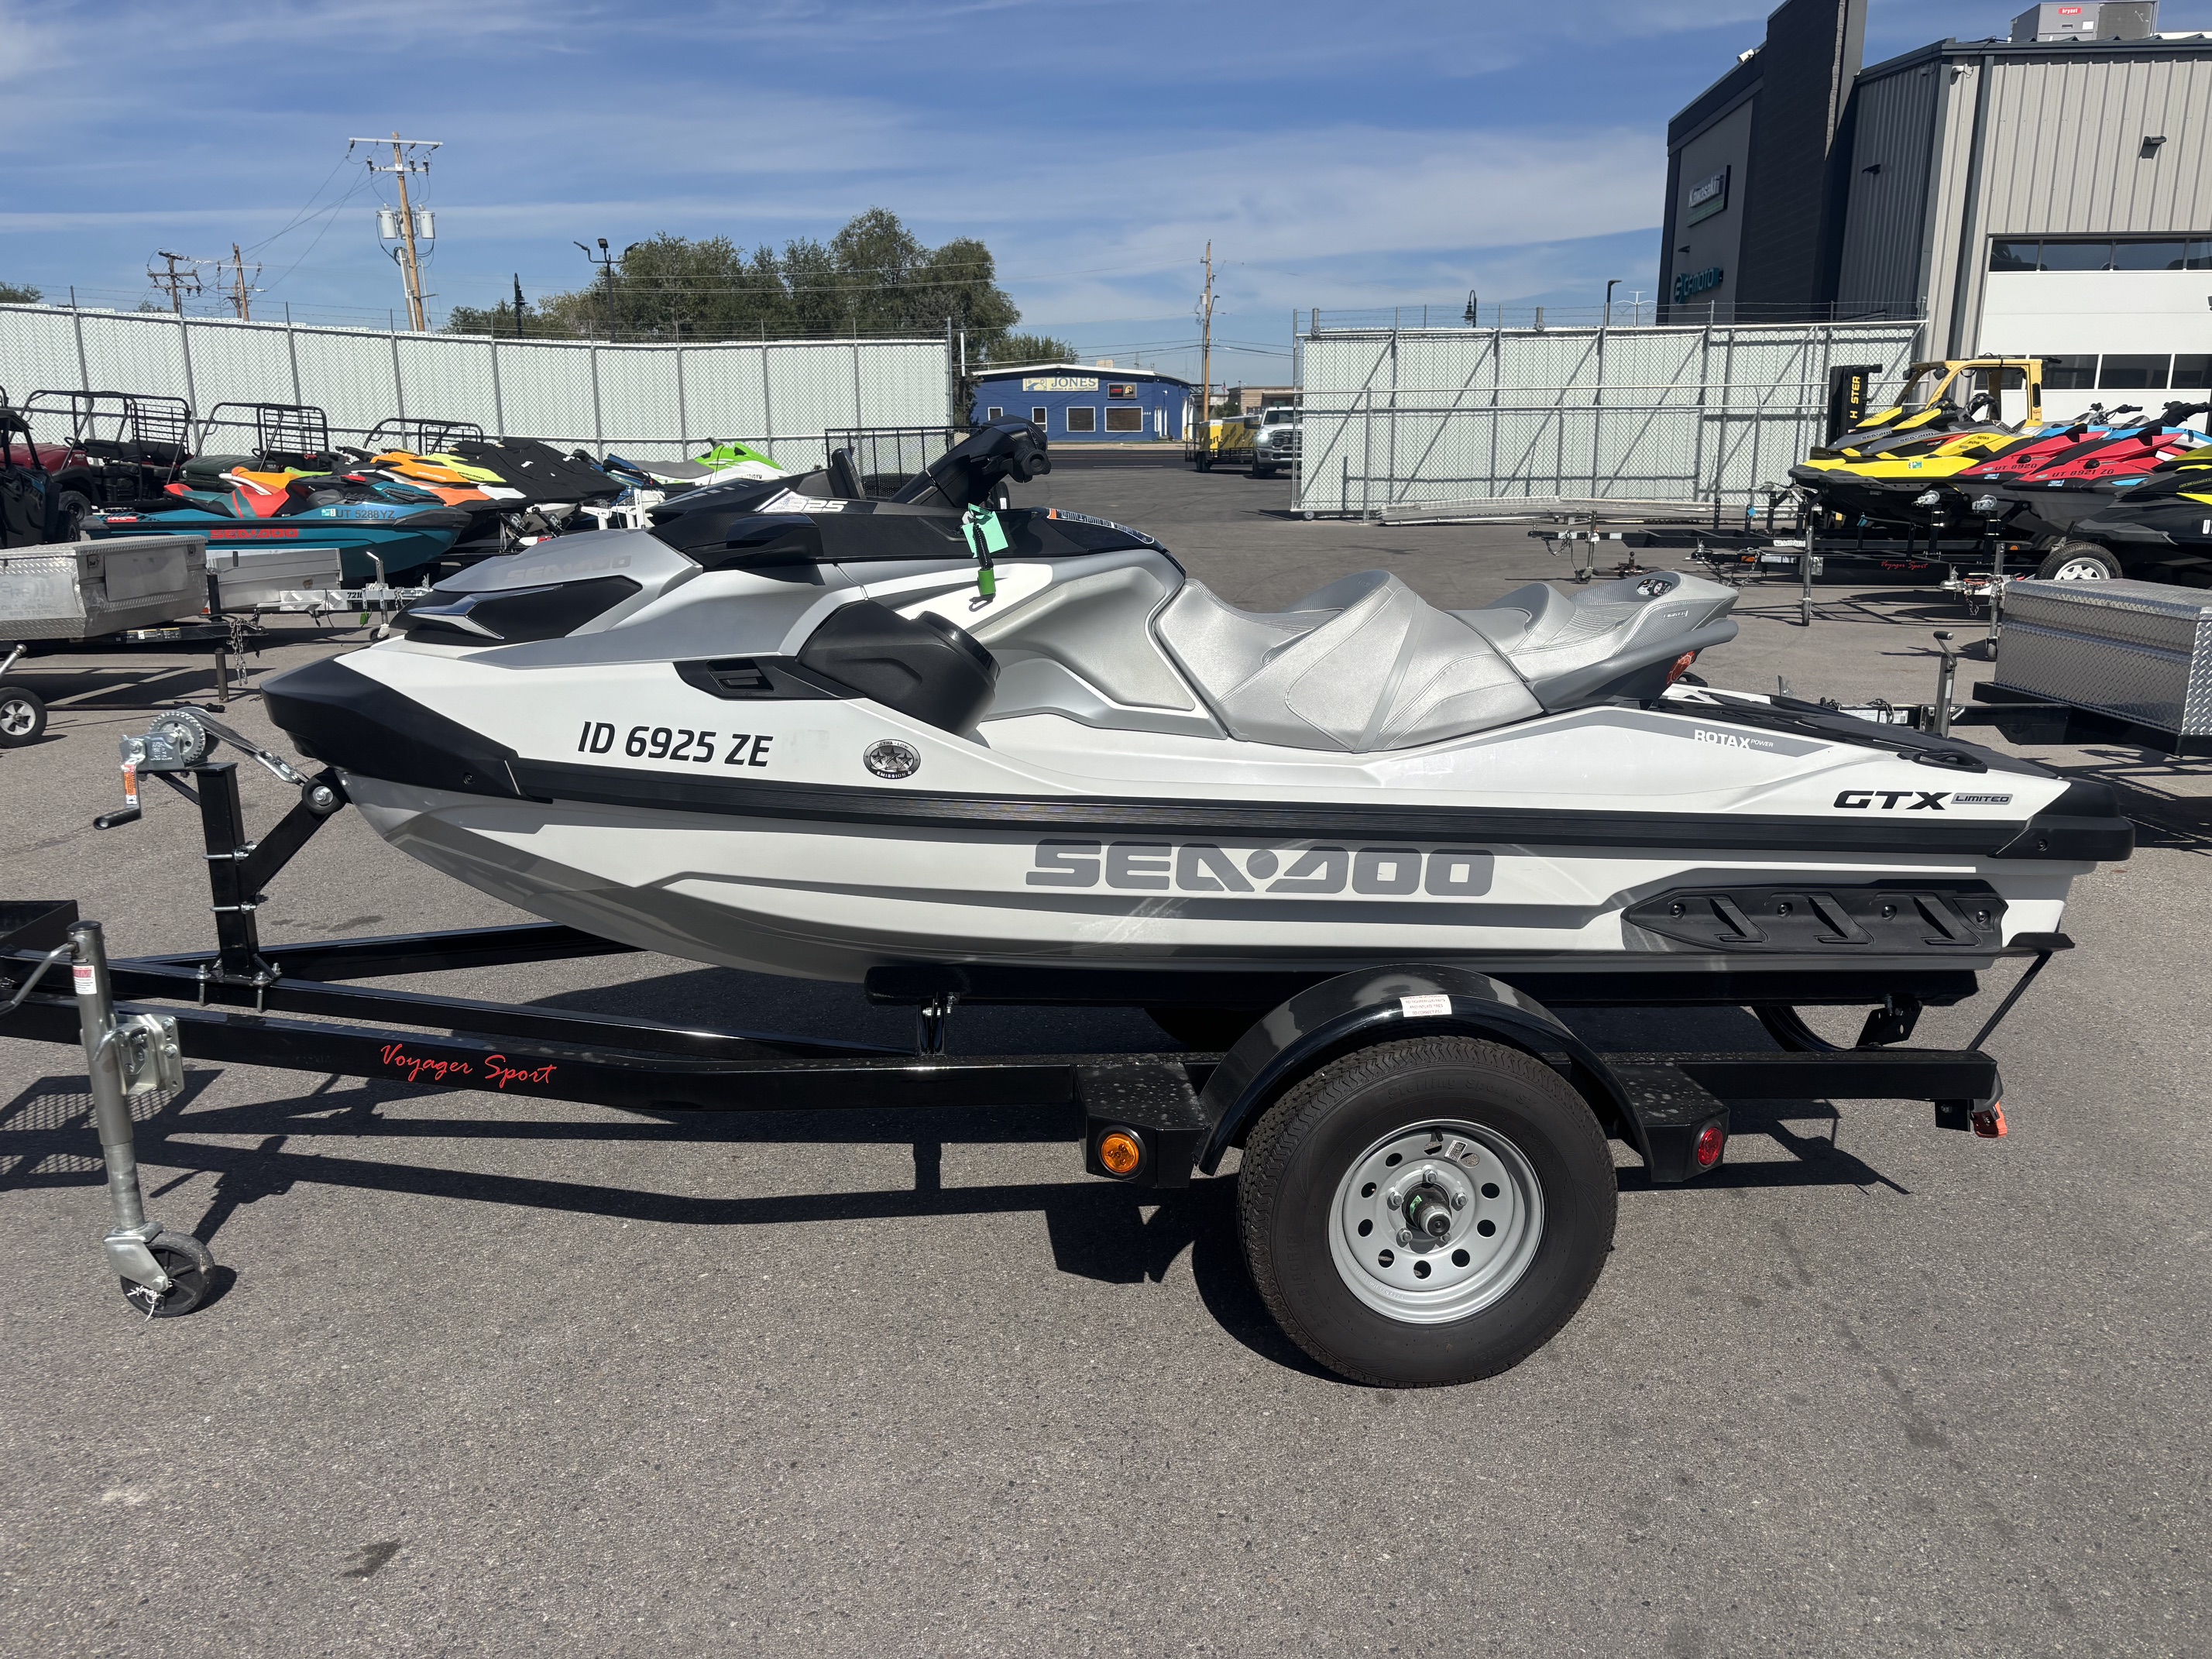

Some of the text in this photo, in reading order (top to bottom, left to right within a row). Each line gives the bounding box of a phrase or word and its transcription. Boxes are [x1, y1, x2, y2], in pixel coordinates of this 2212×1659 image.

[1051, 378, 1096, 387] JONES
[1850, 376, 1860, 419] HSTER
[335, 509, 351, 518] UT
[2202, 519, 2212, 534] U
[1881, 560, 1929, 570] Voyager Sport
[577, 721, 774, 768] ID 6925 ZE
[1694, 729, 1774, 750] ROTAX POWER
[1832, 790, 2010, 811] GTX LIMITED
[380, 1043, 558, 1089] Voyager Sport
[1387, 1077, 1456, 1101] Sterling
